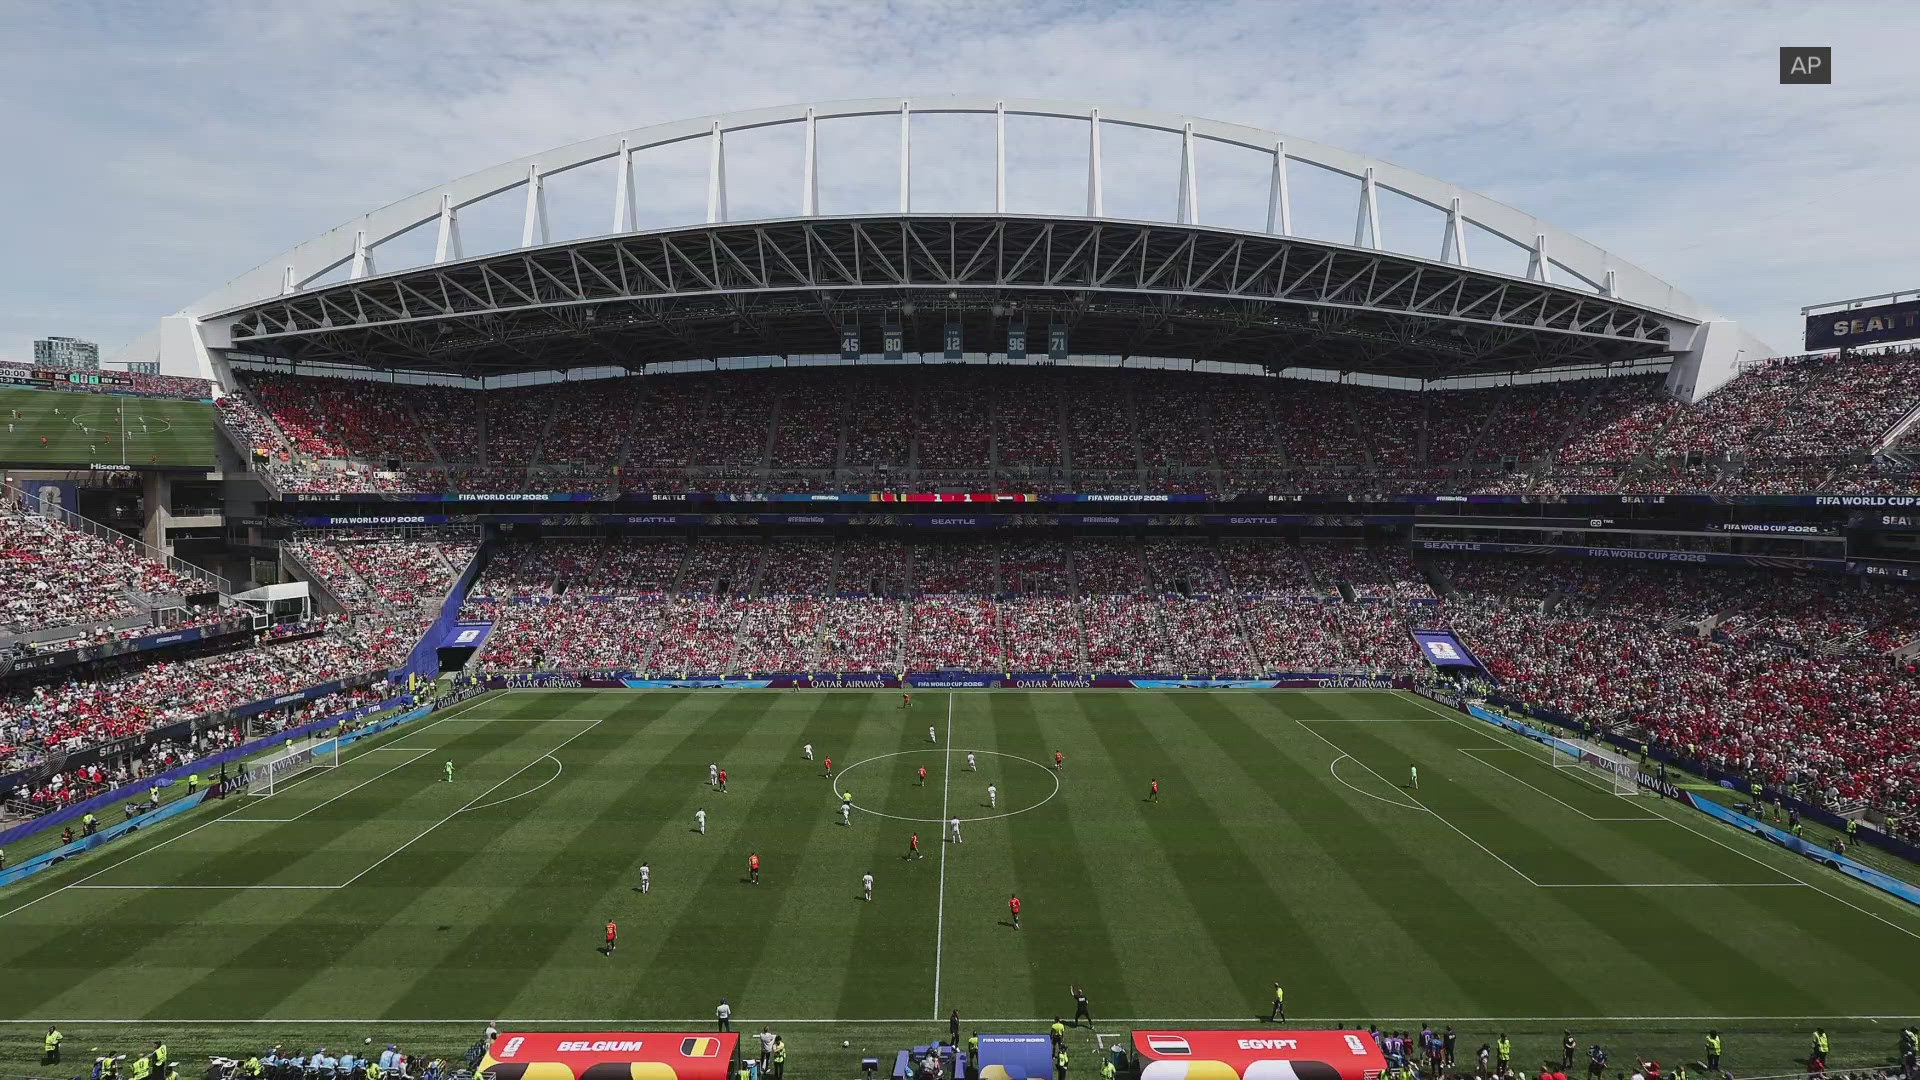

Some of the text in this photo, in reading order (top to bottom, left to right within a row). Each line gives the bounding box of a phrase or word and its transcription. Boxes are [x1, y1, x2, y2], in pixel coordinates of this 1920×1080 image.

[1833, 314, 1916, 336] SEAT
[842, 338, 859, 352] 45
[885, 338, 901, 352] 80
[946, 337, 960, 350] 12
[1009, 338, 1025, 351] 96
[1051, 338, 1065, 351] 71
[90, 463, 131, 471] Hisense
[934, 494, 973, 502] 1 1
[1621, 496, 1665, 504] SEALE
[1816, 496, 1841, 506] FIFA
[1842, 496, 1887, 506] WORLD
[1888, 496, 1913, 506] CUP
[380, 516, 396, 524] CUP
[1723, 523, 1740, 531] FIFA
[1787, 525, 1818, 533] 2026
[1423, 542, 1481, 551] SEATTLE
[1588, 549, 1707, 562] FIFA WORLD CUP 2026
[1866, 566, 1909, 577] SEALE
[14, 657, 55, 671] SEALE
[506, 679, 582, 689] QATAR AIRWAYS
[811, 680, 885, 689] QATAR AIRWAYS
[1016, 680, 1090, 689] QATAR AIRWAYS
[1318, 680, 1393, 689] QATAR AIRWAYS
[1414, 684, 1433, 699] QATAR
[437, 692, 460, 709] QATAR
[99, 733, 146, 757] SEATLE
[219, 754, 303, 793] QATAR AIRWAYS
[1598, 757, 1679, 799] QATAR AIRWAYS
[557, 1040, 643, 1052] BELGIUM
[1236, 1039, 1297, 1050] EGYPT
